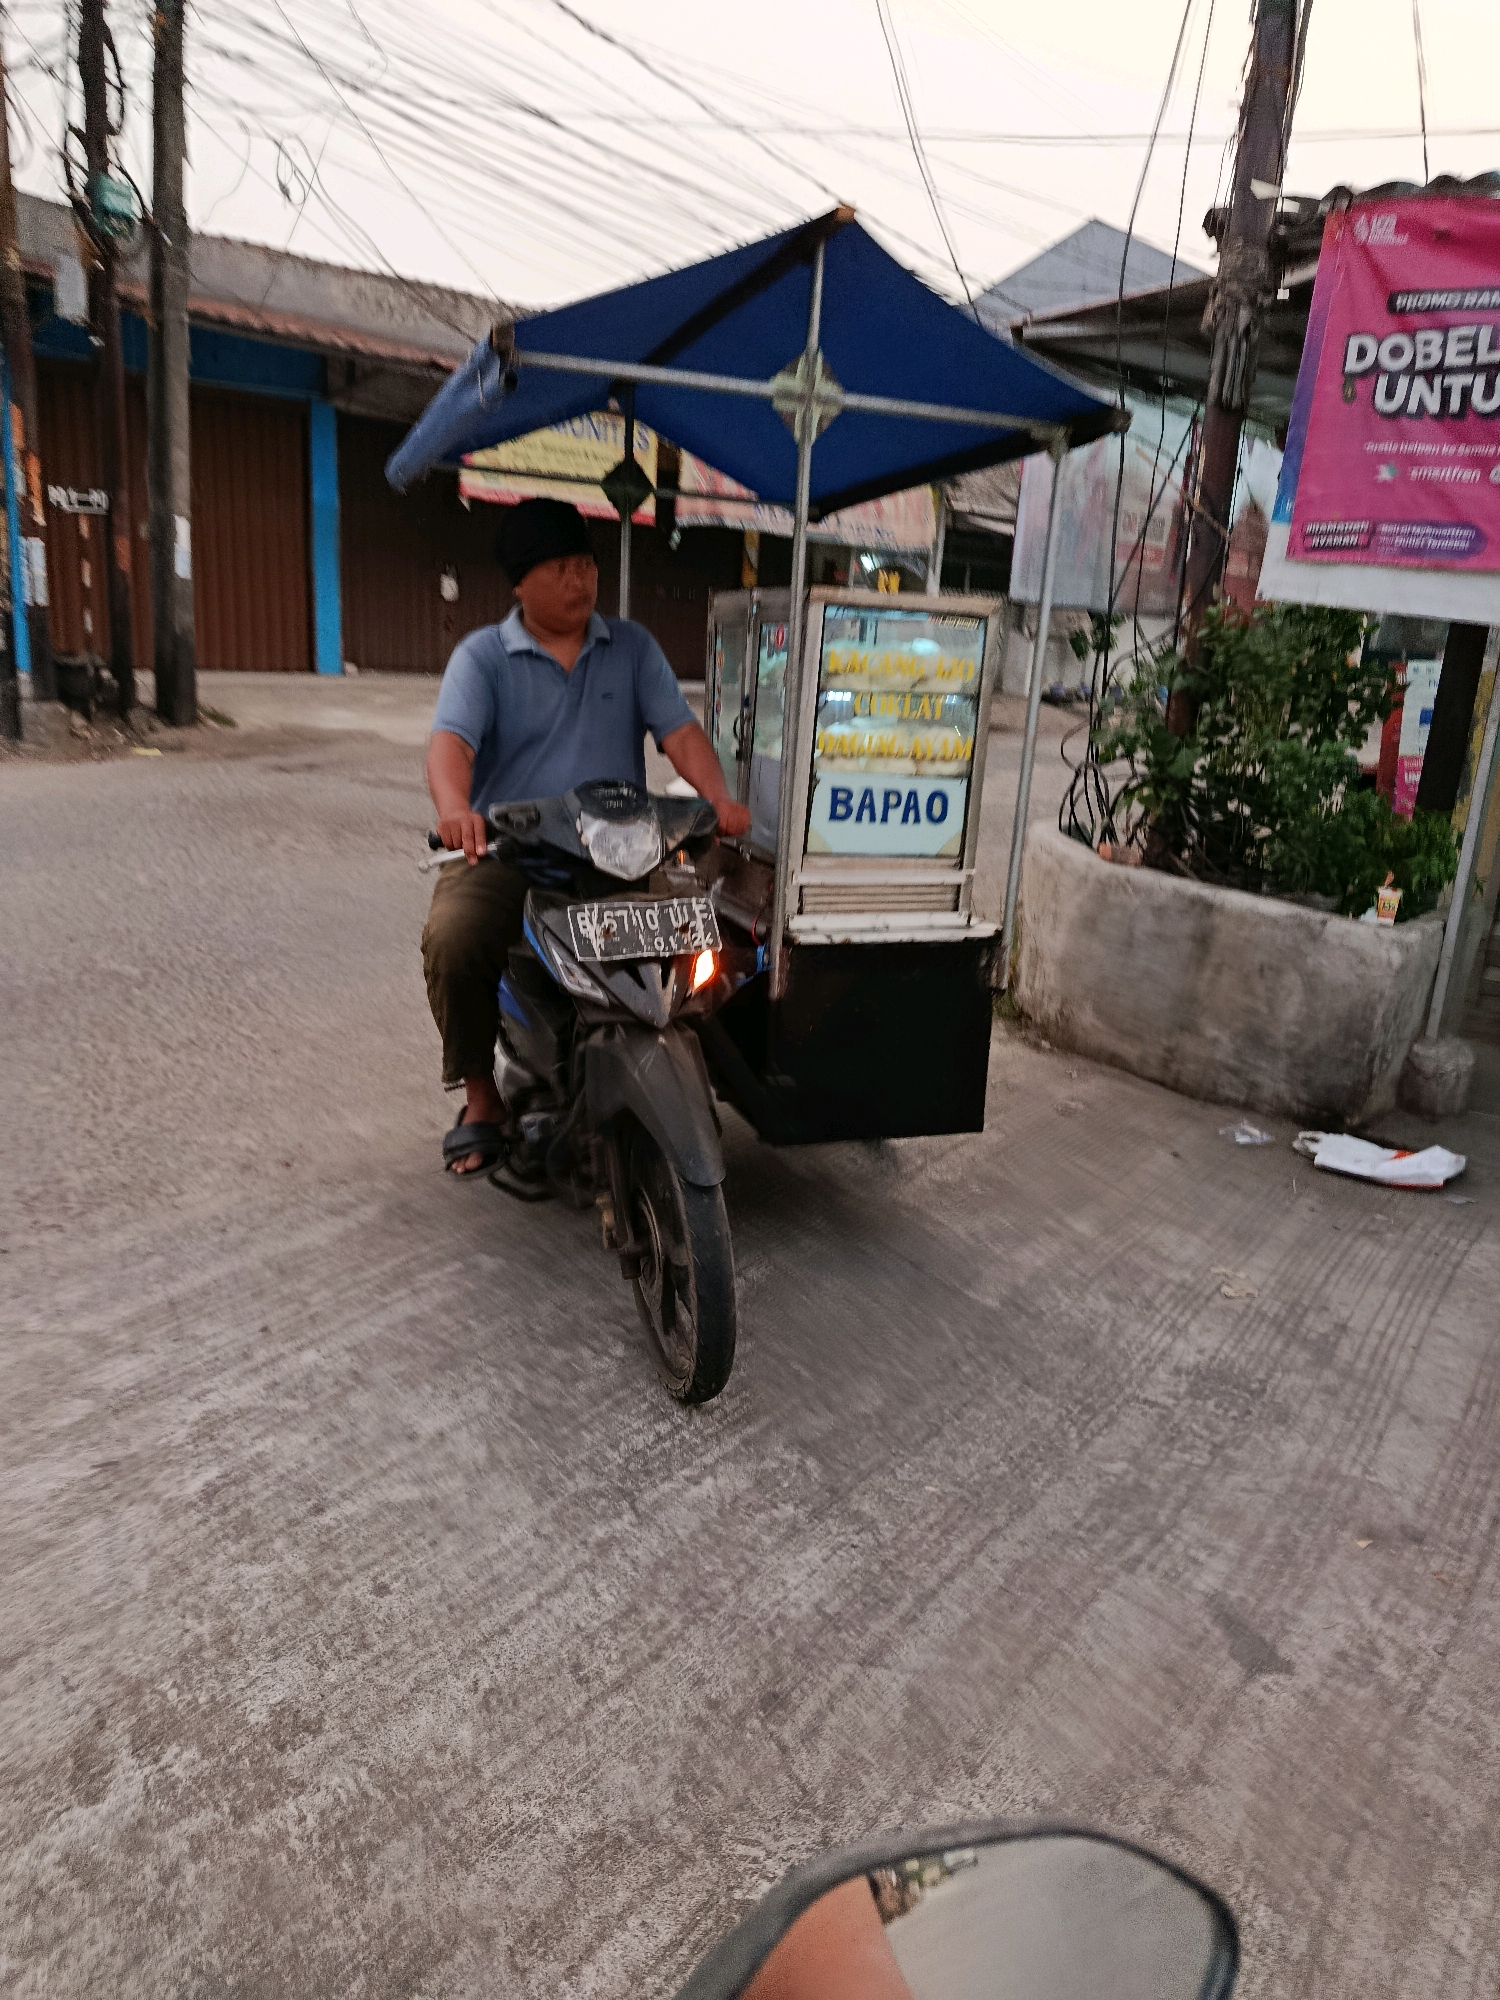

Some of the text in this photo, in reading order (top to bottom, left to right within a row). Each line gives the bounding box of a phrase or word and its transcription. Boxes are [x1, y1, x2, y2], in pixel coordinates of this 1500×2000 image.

[1343, 325, 1500, 373] DOBEL
[853, 691, 945, 721] COKLAT
[908, 734, 974, 761] AYAM
[828, 785, 950, 826] BAPAO
